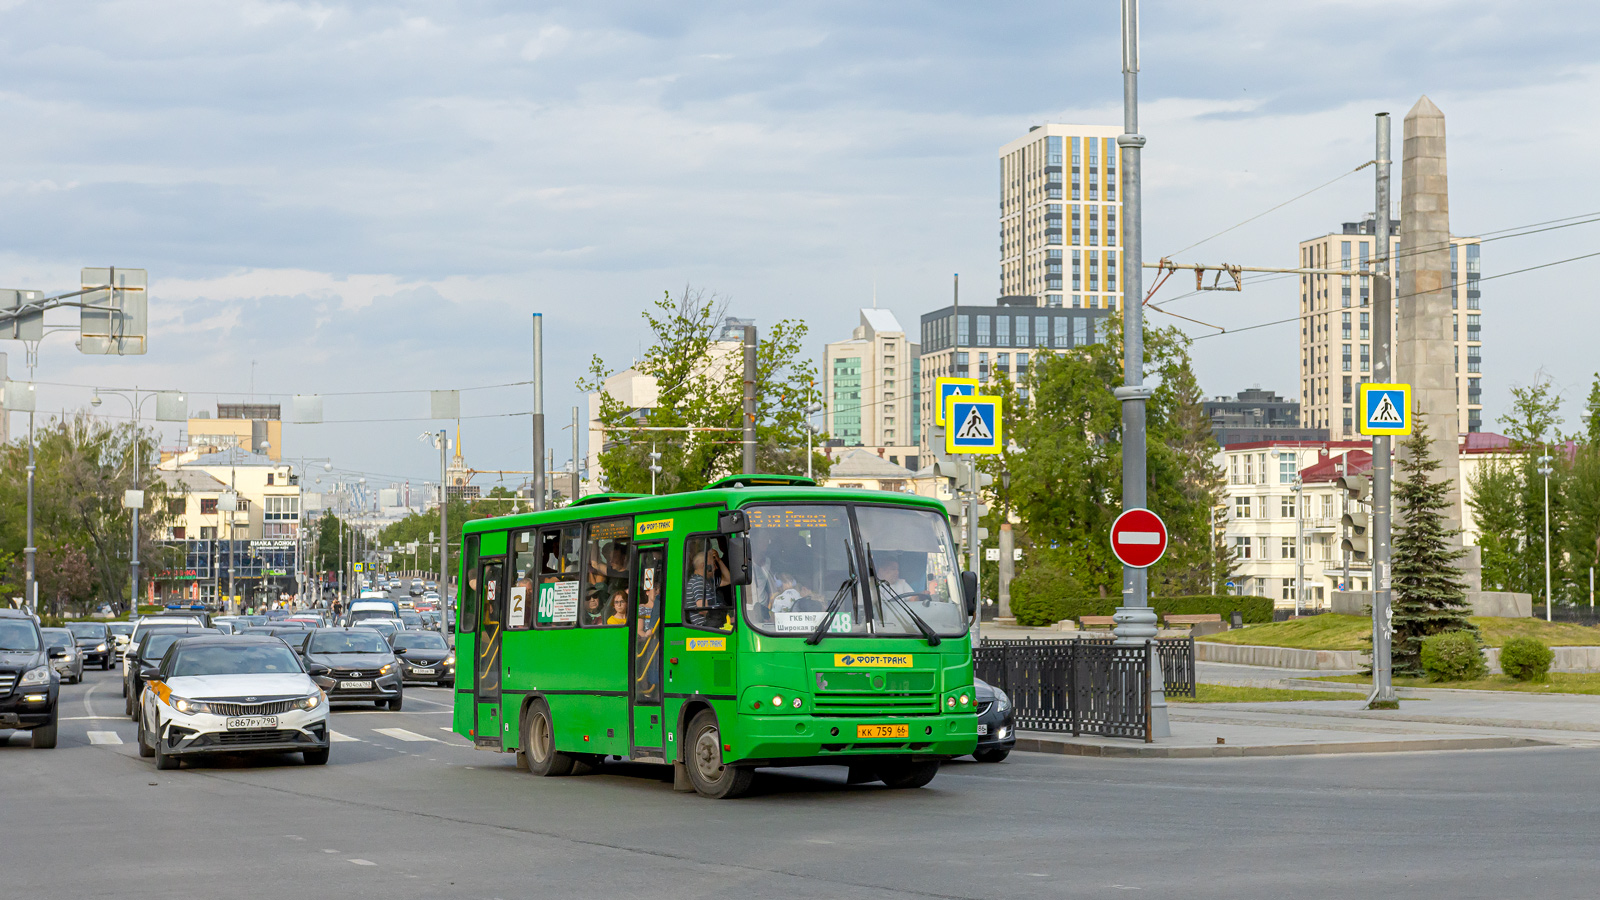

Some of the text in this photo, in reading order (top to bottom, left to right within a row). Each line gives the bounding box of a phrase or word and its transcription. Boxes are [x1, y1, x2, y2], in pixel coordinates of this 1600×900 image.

[646, 521, 671, 530] ФОРТ-ТРАНС
[513, 594, 523, 612] 2
[538, 587, 554, 618] 48
[777, 624, 809, 632] Широкая
[831, 613, 852, 633] 48
[856, 656, 907, 665] ФОРТ-ТРАНС
[876, 726, 893, 737] 759
[896, 725, 906, 734] 66
